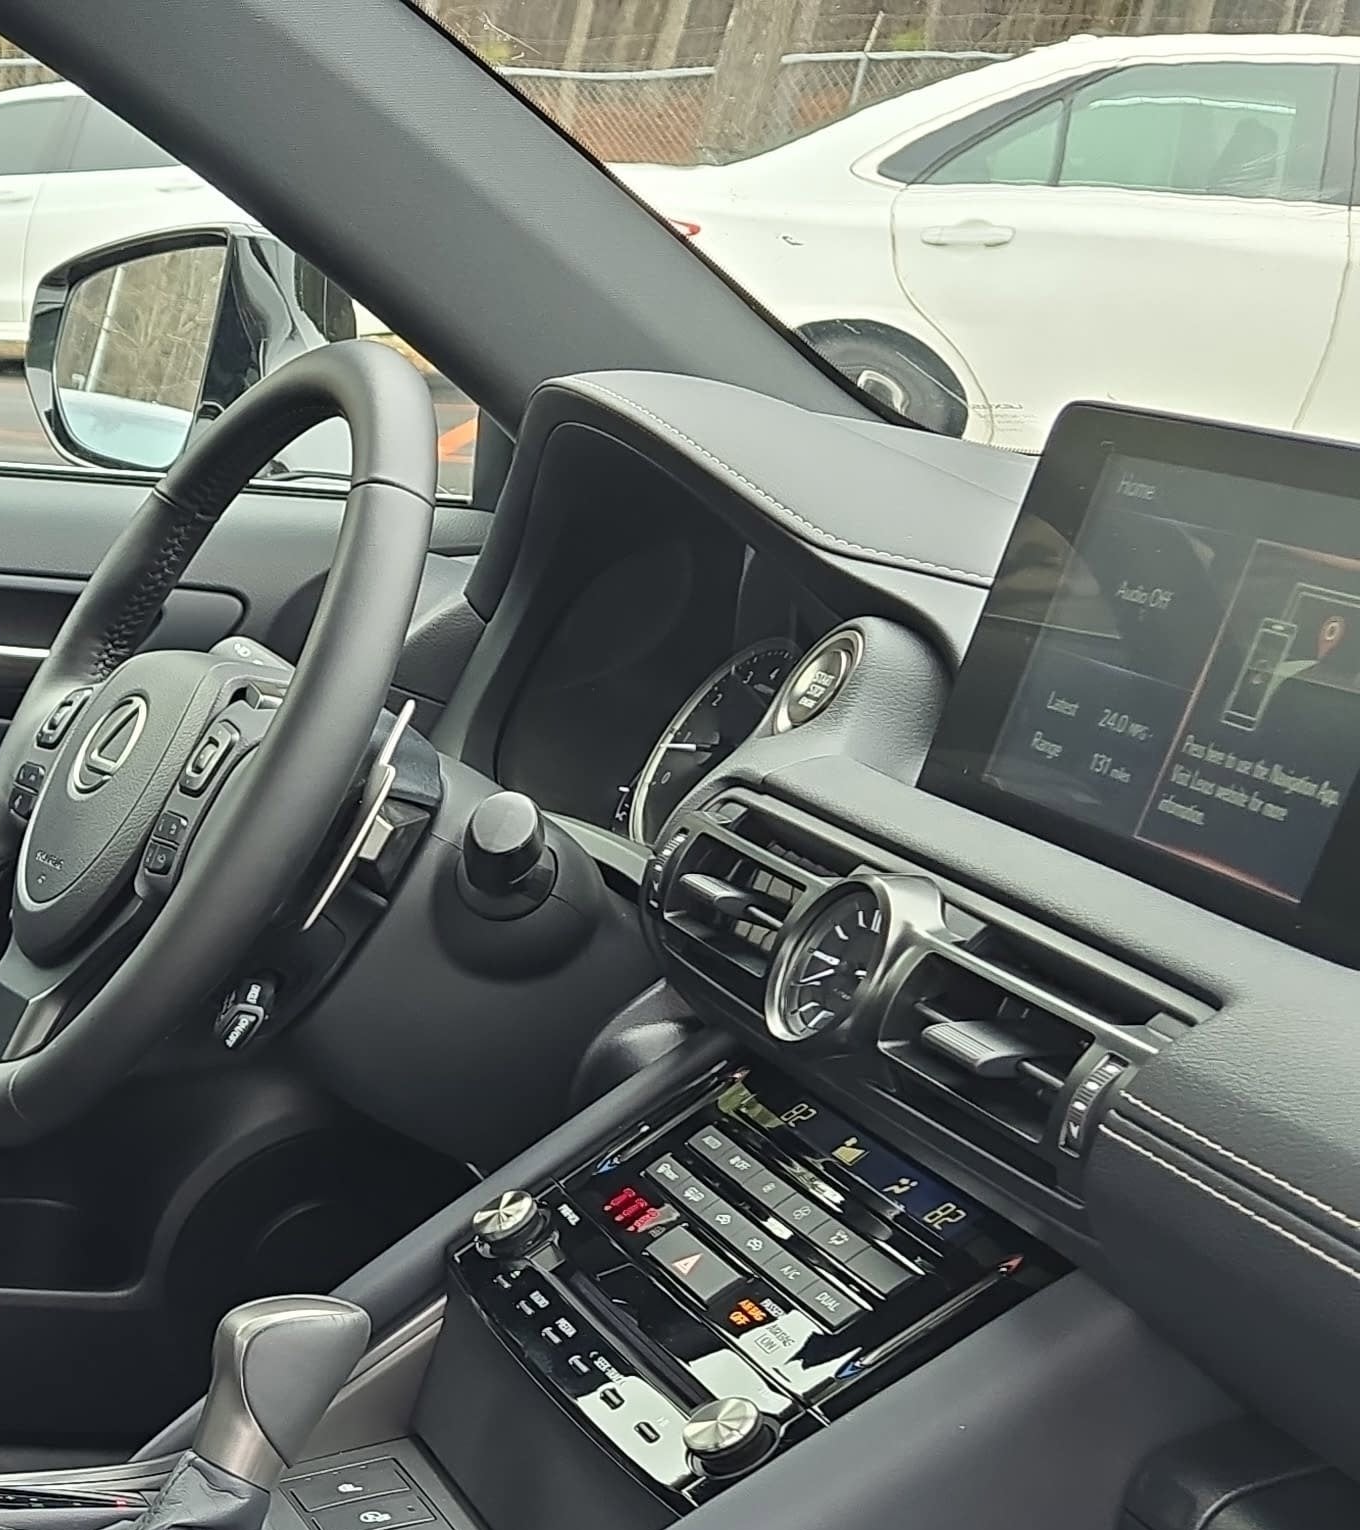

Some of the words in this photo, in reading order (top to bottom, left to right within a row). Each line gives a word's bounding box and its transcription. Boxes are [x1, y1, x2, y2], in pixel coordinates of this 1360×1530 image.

[1117, 473, 1157, 500] Home
[781, 1103, 816, 1127] 82
[922, 1202, 967, 1230] 82
[779, 1264, 802, 1281] A/C
[815, 1291, 841, 1313] DUAL
